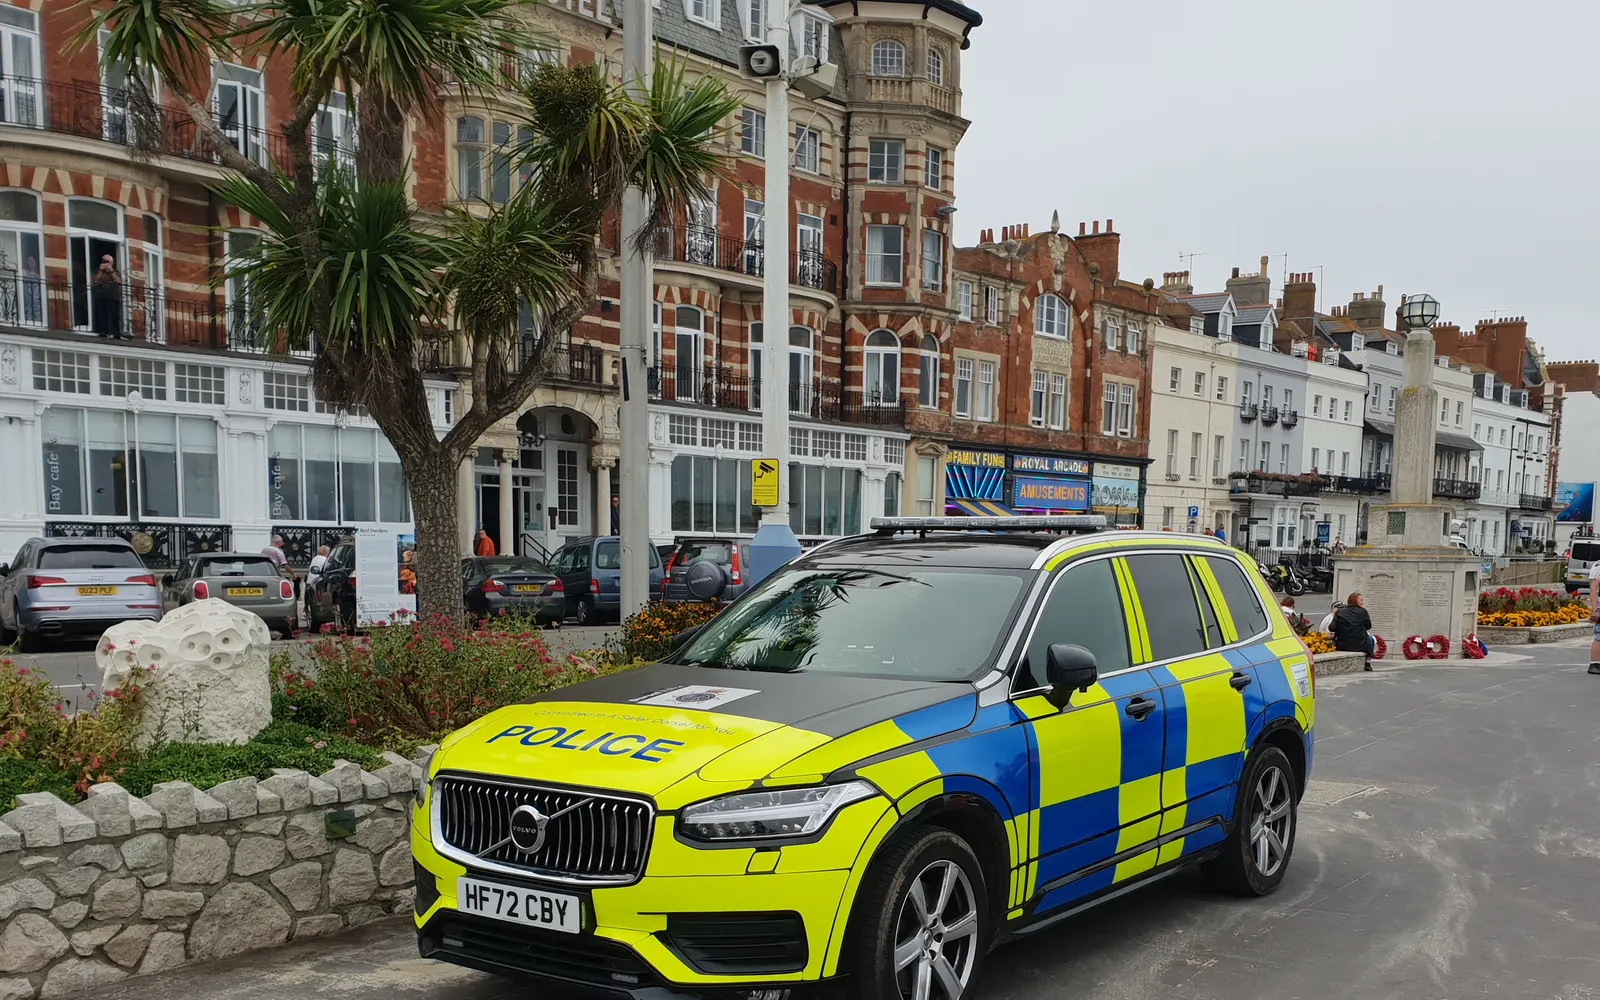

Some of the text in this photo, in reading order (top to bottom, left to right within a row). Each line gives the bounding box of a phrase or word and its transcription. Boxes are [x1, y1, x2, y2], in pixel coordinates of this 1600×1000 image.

[953, 451, 998, 467] FAMILY FUN
[1021, 457, 1083, 473] ROYAL ARCADE
[49, 485, 63, 510] Bay
[1020, 484, 1085, 501] AMUSEMENTS
[273, 493, 284, 516] Bay
[691, 576, 713, 585] HONDA
[651, 718, 693, 728] Dorset
[713, 726, 737, 736] You
[485, 725, 685, 763] POLICE
[512, 825, 537, 834] VOLVO
[465, 883, 568, 926] HF72 CBY
